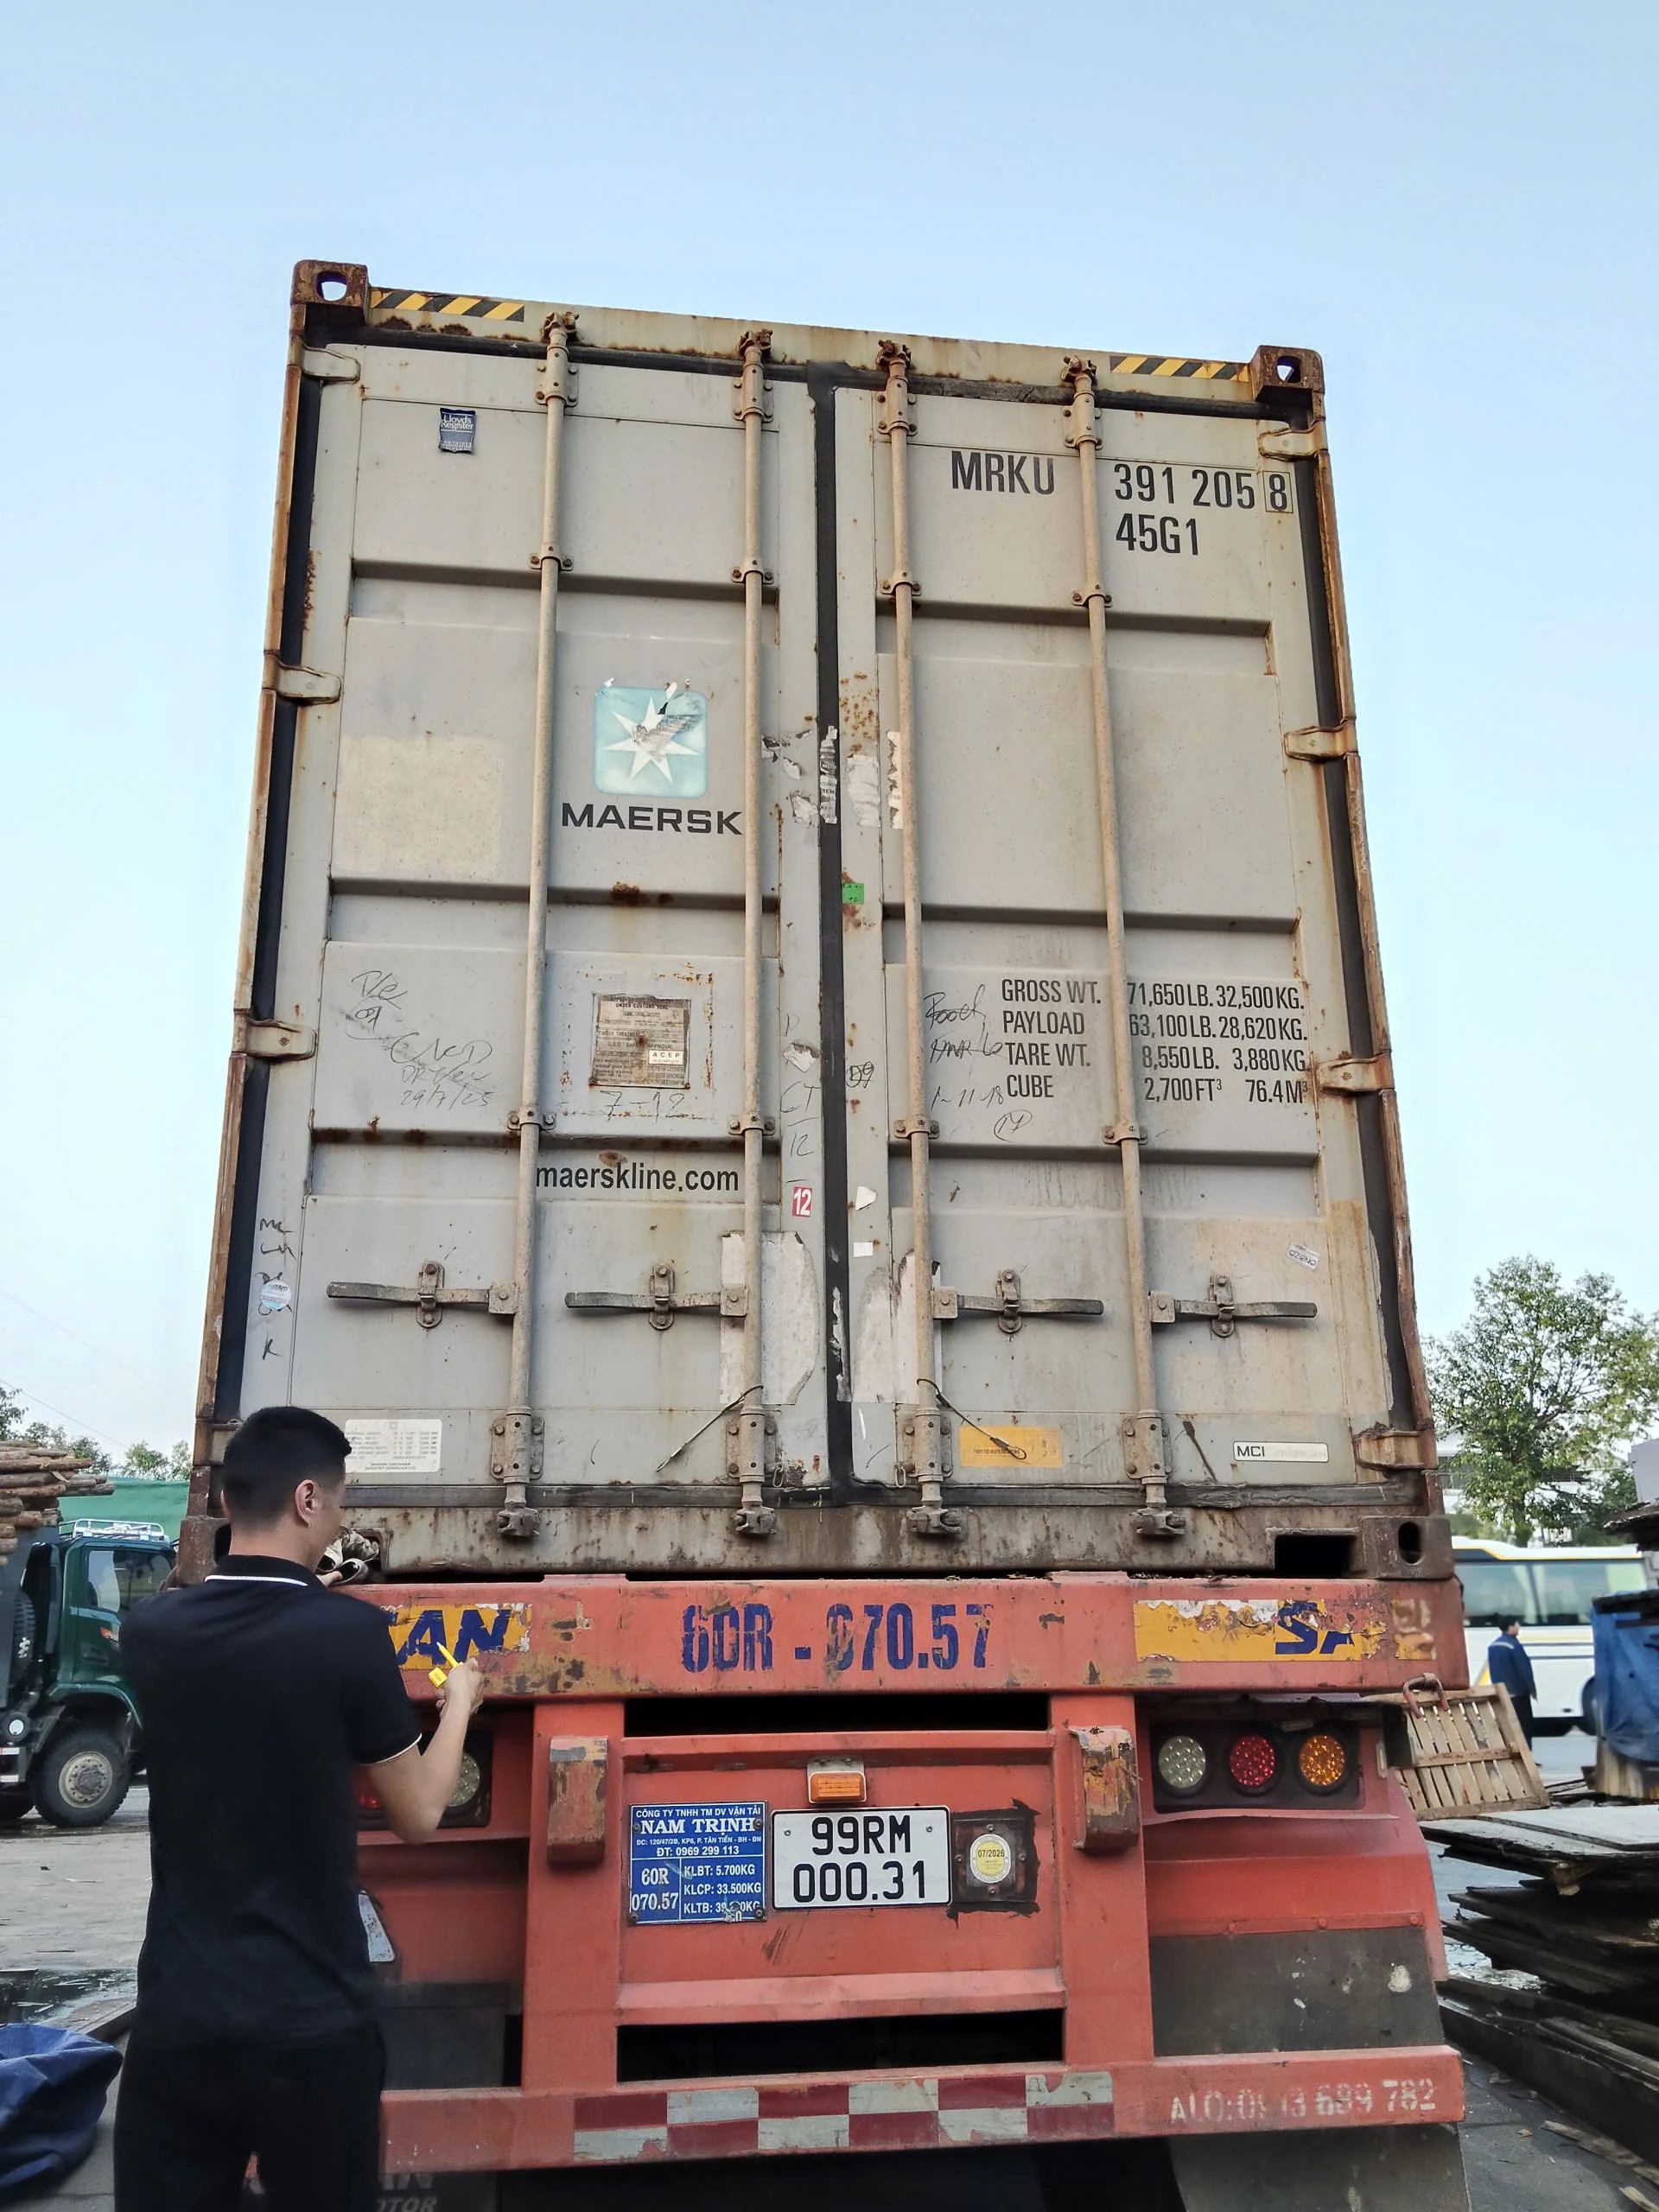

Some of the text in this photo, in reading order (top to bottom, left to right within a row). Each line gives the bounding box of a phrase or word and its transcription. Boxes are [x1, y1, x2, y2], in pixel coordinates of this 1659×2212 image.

[442, 420, 474, 430] Register
[950, 450, 1287, 512] MRKU 391 205 8
[1116, 512, 1198, 556] 45G1
[562, 802, 743, 836] MAERSK
[1001, 979, 1061, 1004] GROSS
[1066, 981, 1102, 1005] WT.
[1002, 1010, 1084, 1035] PAYLOAD
[1005, 1043, 1051, 1066] TARE
[1056, 1043, 1090, 1067] WT.
[1007, 1074, 1053, 1099] CUBE
[536, 1162, 739, 1192] maerskline.com
[794, 1188, 811, 1216] 12
[1236, 1446, 1265, 1457] MCI
[683, 1603, 773, 1672] 60R
[826, 1603, 994, 1672] 070.57
[636, 1808, 660, 1820] CÔNG
[676, 1808, 698, 1817] TNHH
[715, 1808, 726, 1816] DV
[728, 1806, 745, 1817] VẬN
[747, 1805, 760, 1815] TẢI
[640, 1817, 755, 1836] NAM TRỊNH
[811, 1815, 911, 1855] 99RM
[657, 1845, 740, 1857] ĐT: 0969 299 113
[977, 1849, 1005, 1858] 07/2026
[641, 1867, 670, 1885] 60R
[683, 1864, 755, 1877] KLBT: 5.700KG
[793, 1859, 925, 1903] 000.31
[683, 1882, 761, 1896] KLCP: 33.500KG
[631, 1892, 679, 1911] 070.57
[683, 1902, 713, 1914] KLTB:
[1383, 2079, 1436, 2112] 782
